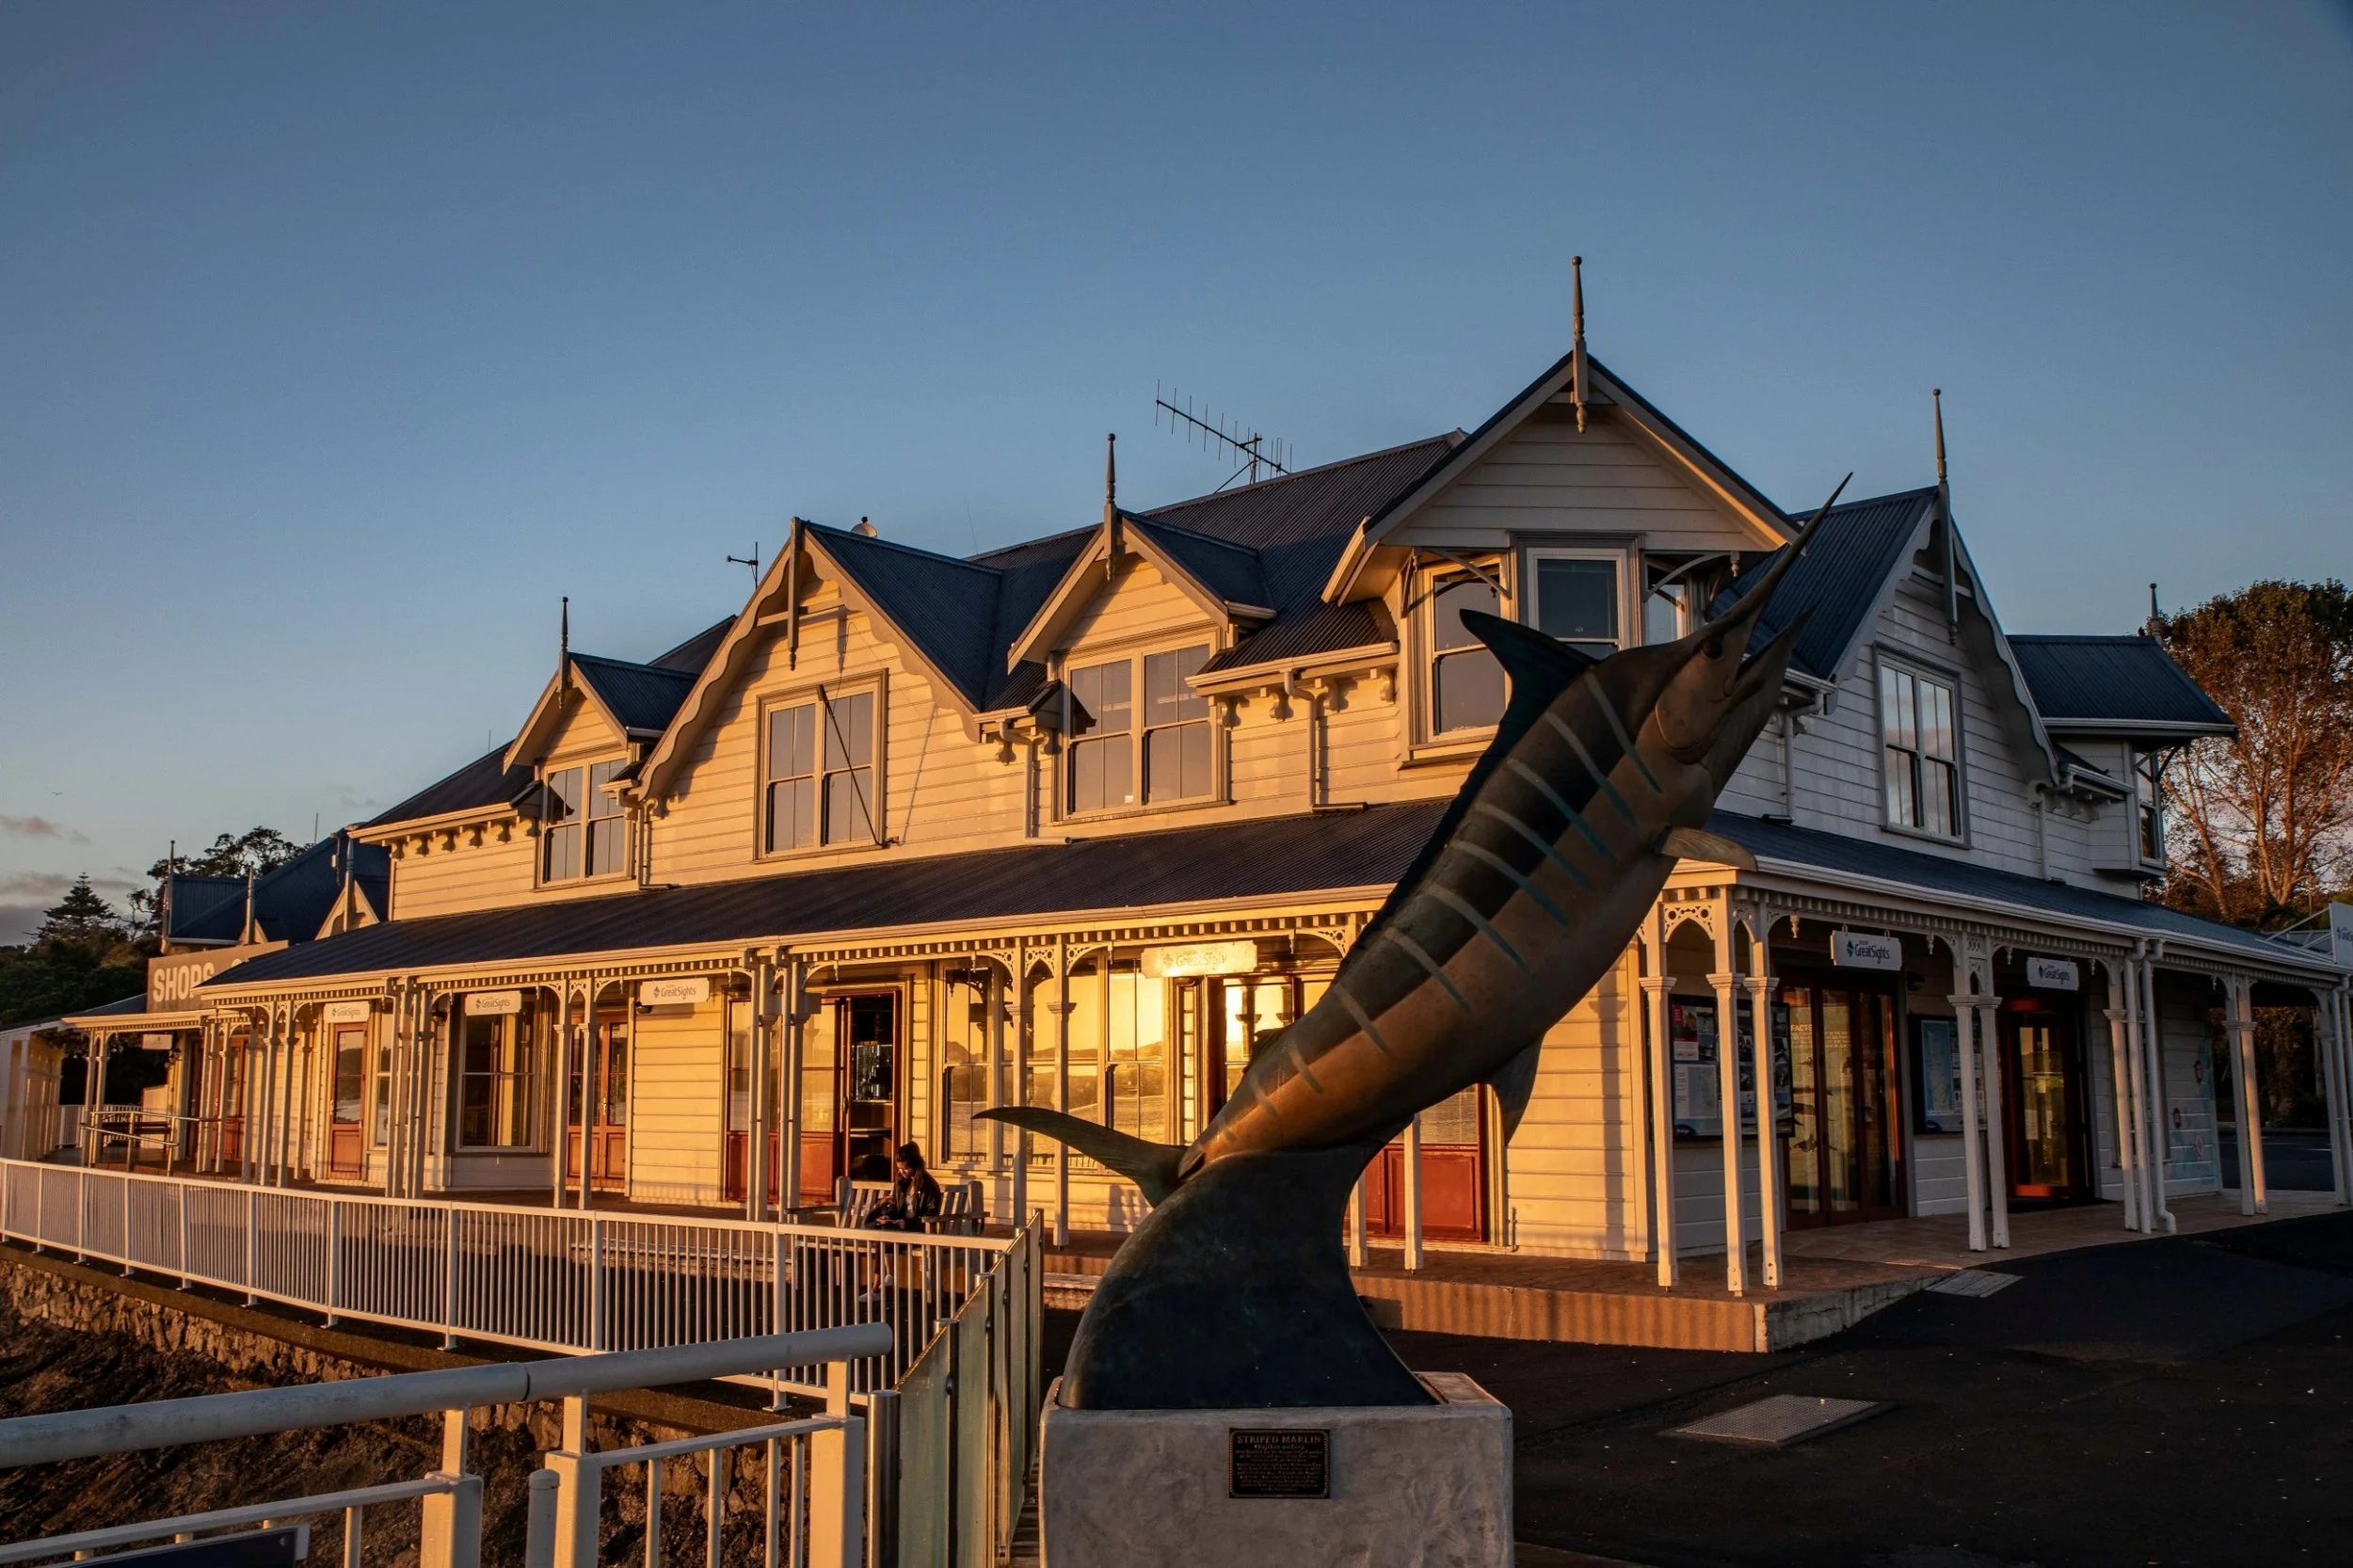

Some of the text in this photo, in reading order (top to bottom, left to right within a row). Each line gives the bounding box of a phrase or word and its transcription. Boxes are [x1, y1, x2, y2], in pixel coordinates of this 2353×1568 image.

[1854, 943, 1891, 965] GreatSights
[661, 985, 696, 1000] GreatSights
[1237, 1434, 1321, 1444] STRIPED MARLIN
